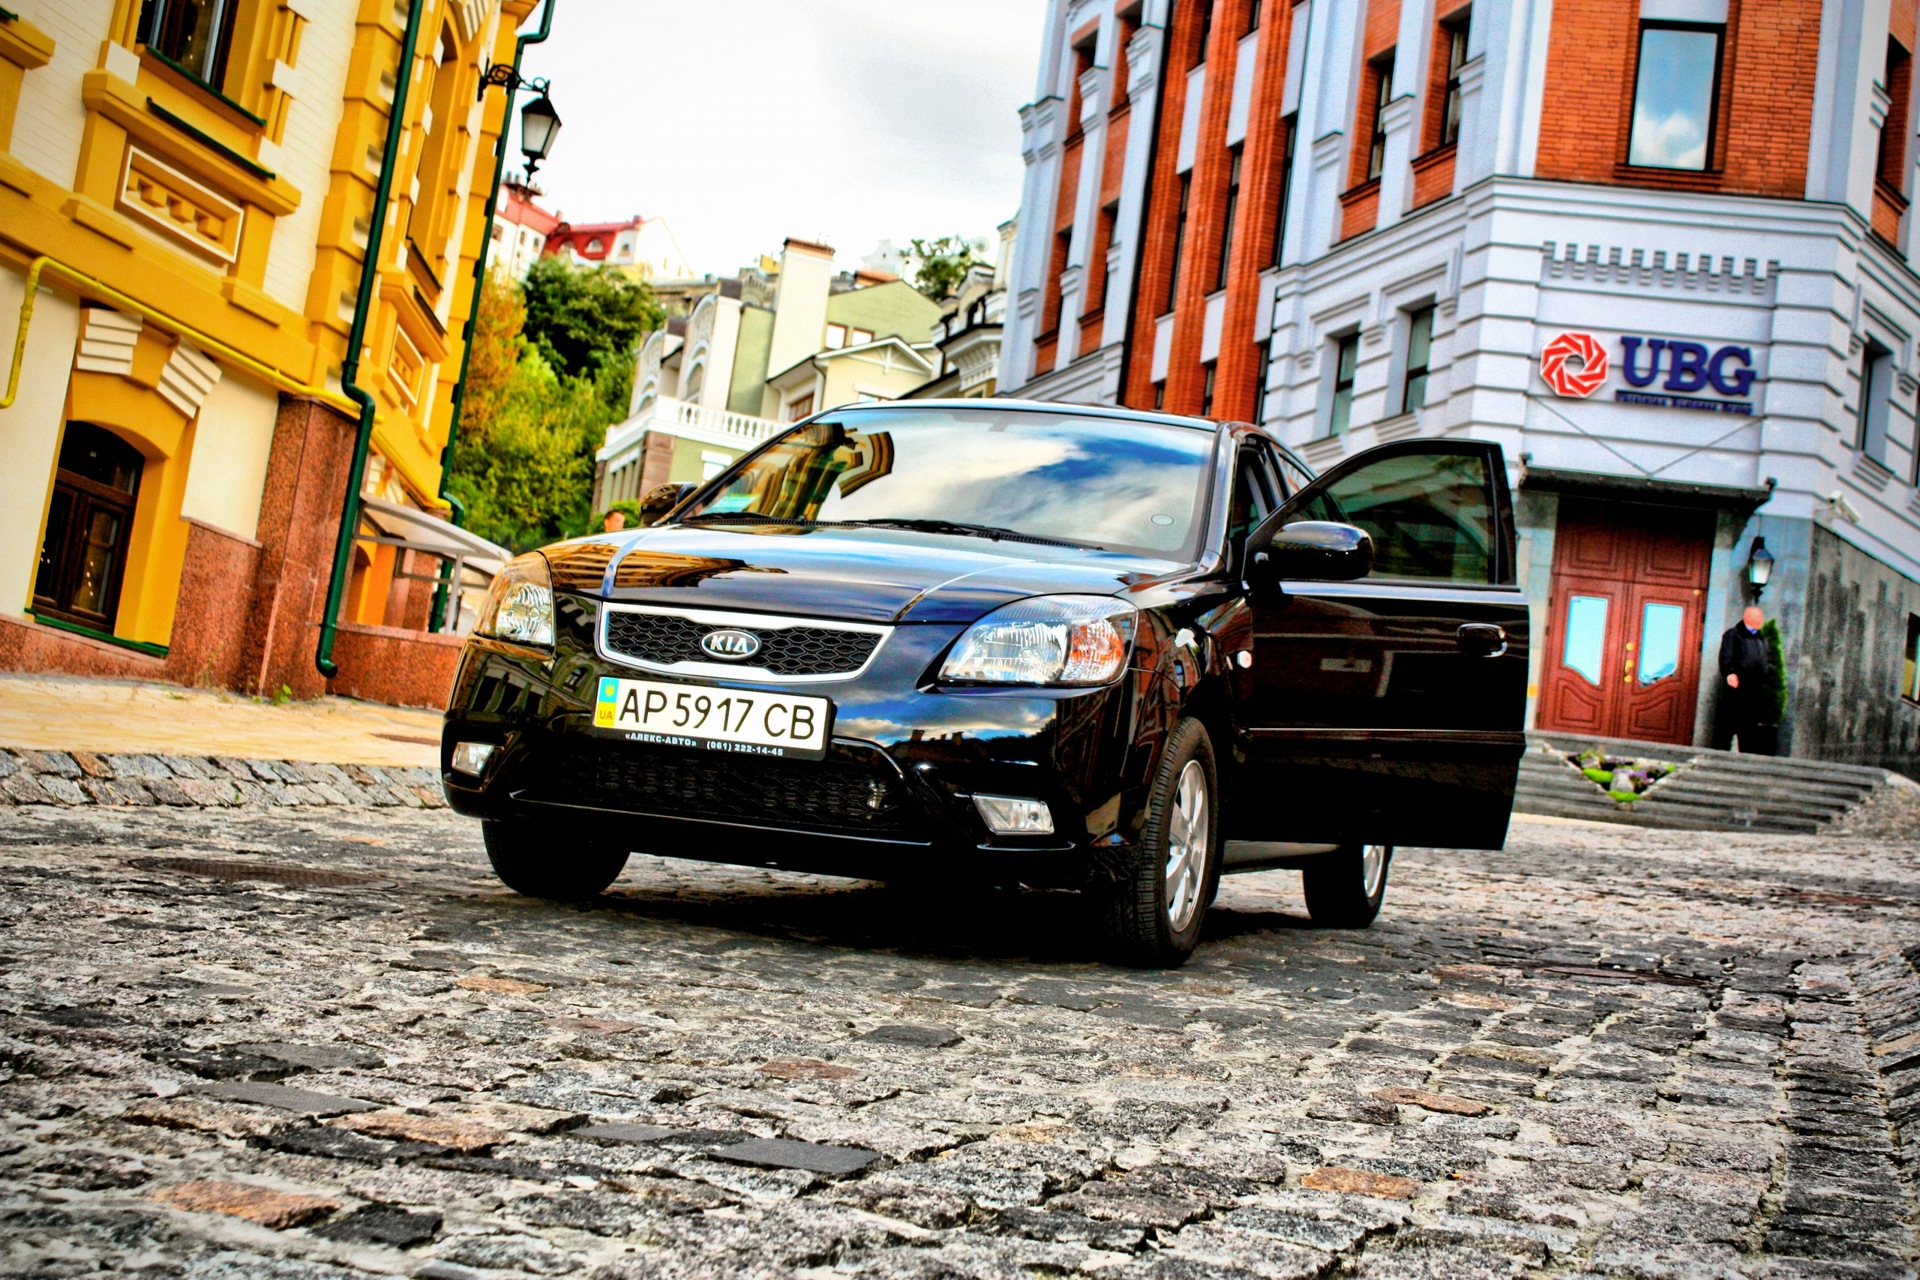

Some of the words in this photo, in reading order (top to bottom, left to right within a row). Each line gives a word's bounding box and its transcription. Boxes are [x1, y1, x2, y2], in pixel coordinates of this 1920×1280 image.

[1620, 336, 1756, 396] UBG
[709, 635, 749, 654] KIA
[599, 710, 613, 721] UA
[619, 688, 667, 723] AP
[673, 693, 754, 732] 5917
[764, 703, 815, 740] CB
[706, 740, 732, 752] (061)
